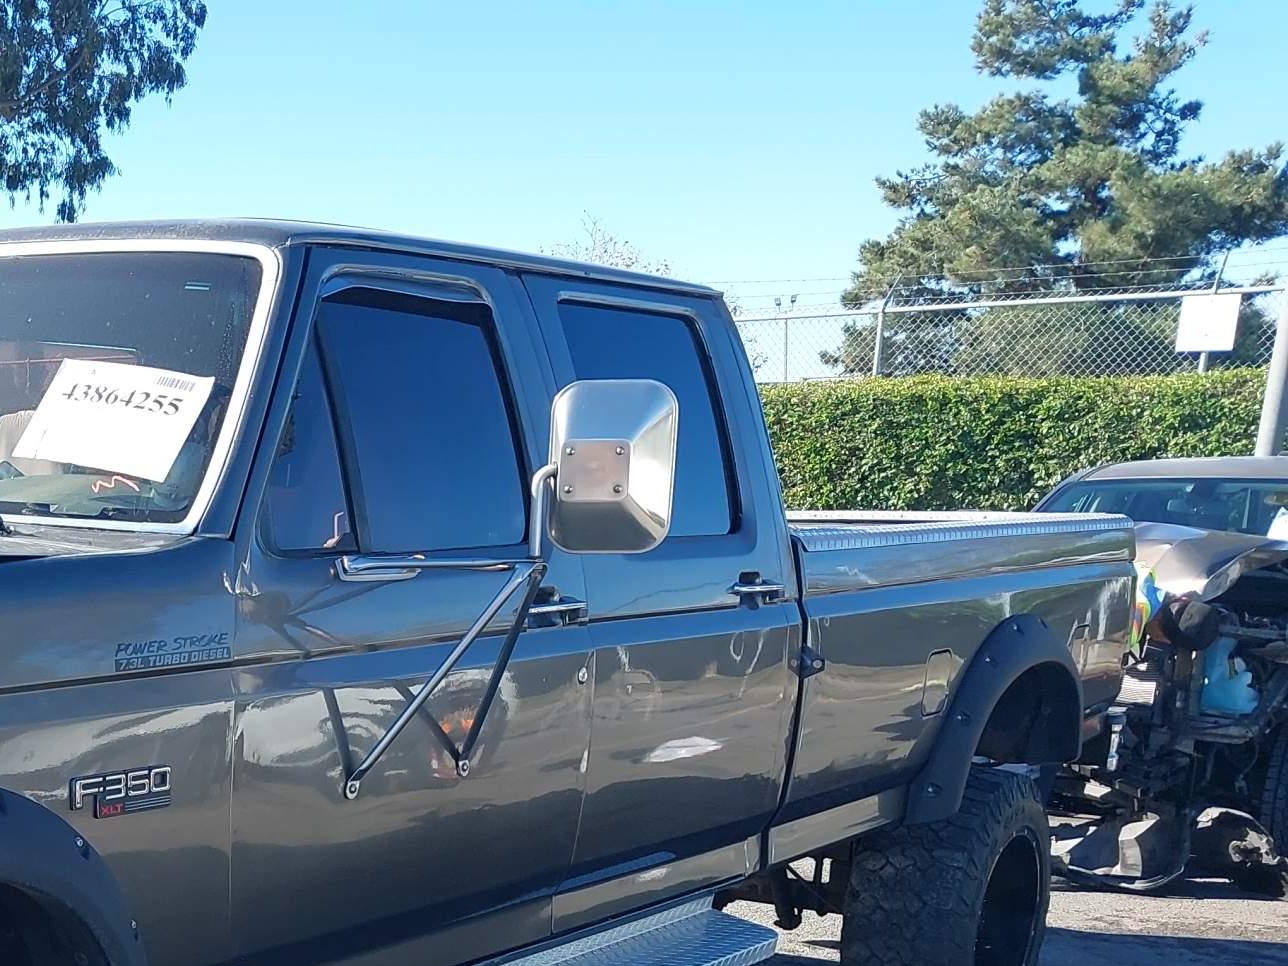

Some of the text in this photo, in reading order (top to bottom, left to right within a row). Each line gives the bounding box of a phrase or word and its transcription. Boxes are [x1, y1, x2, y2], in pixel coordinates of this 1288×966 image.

[62, 383, 184, 416] 43864255
[115, 632, 229, 657] POWER STROKE
[119, 648, 229, 670] 7.3L TURBO DIESEL
